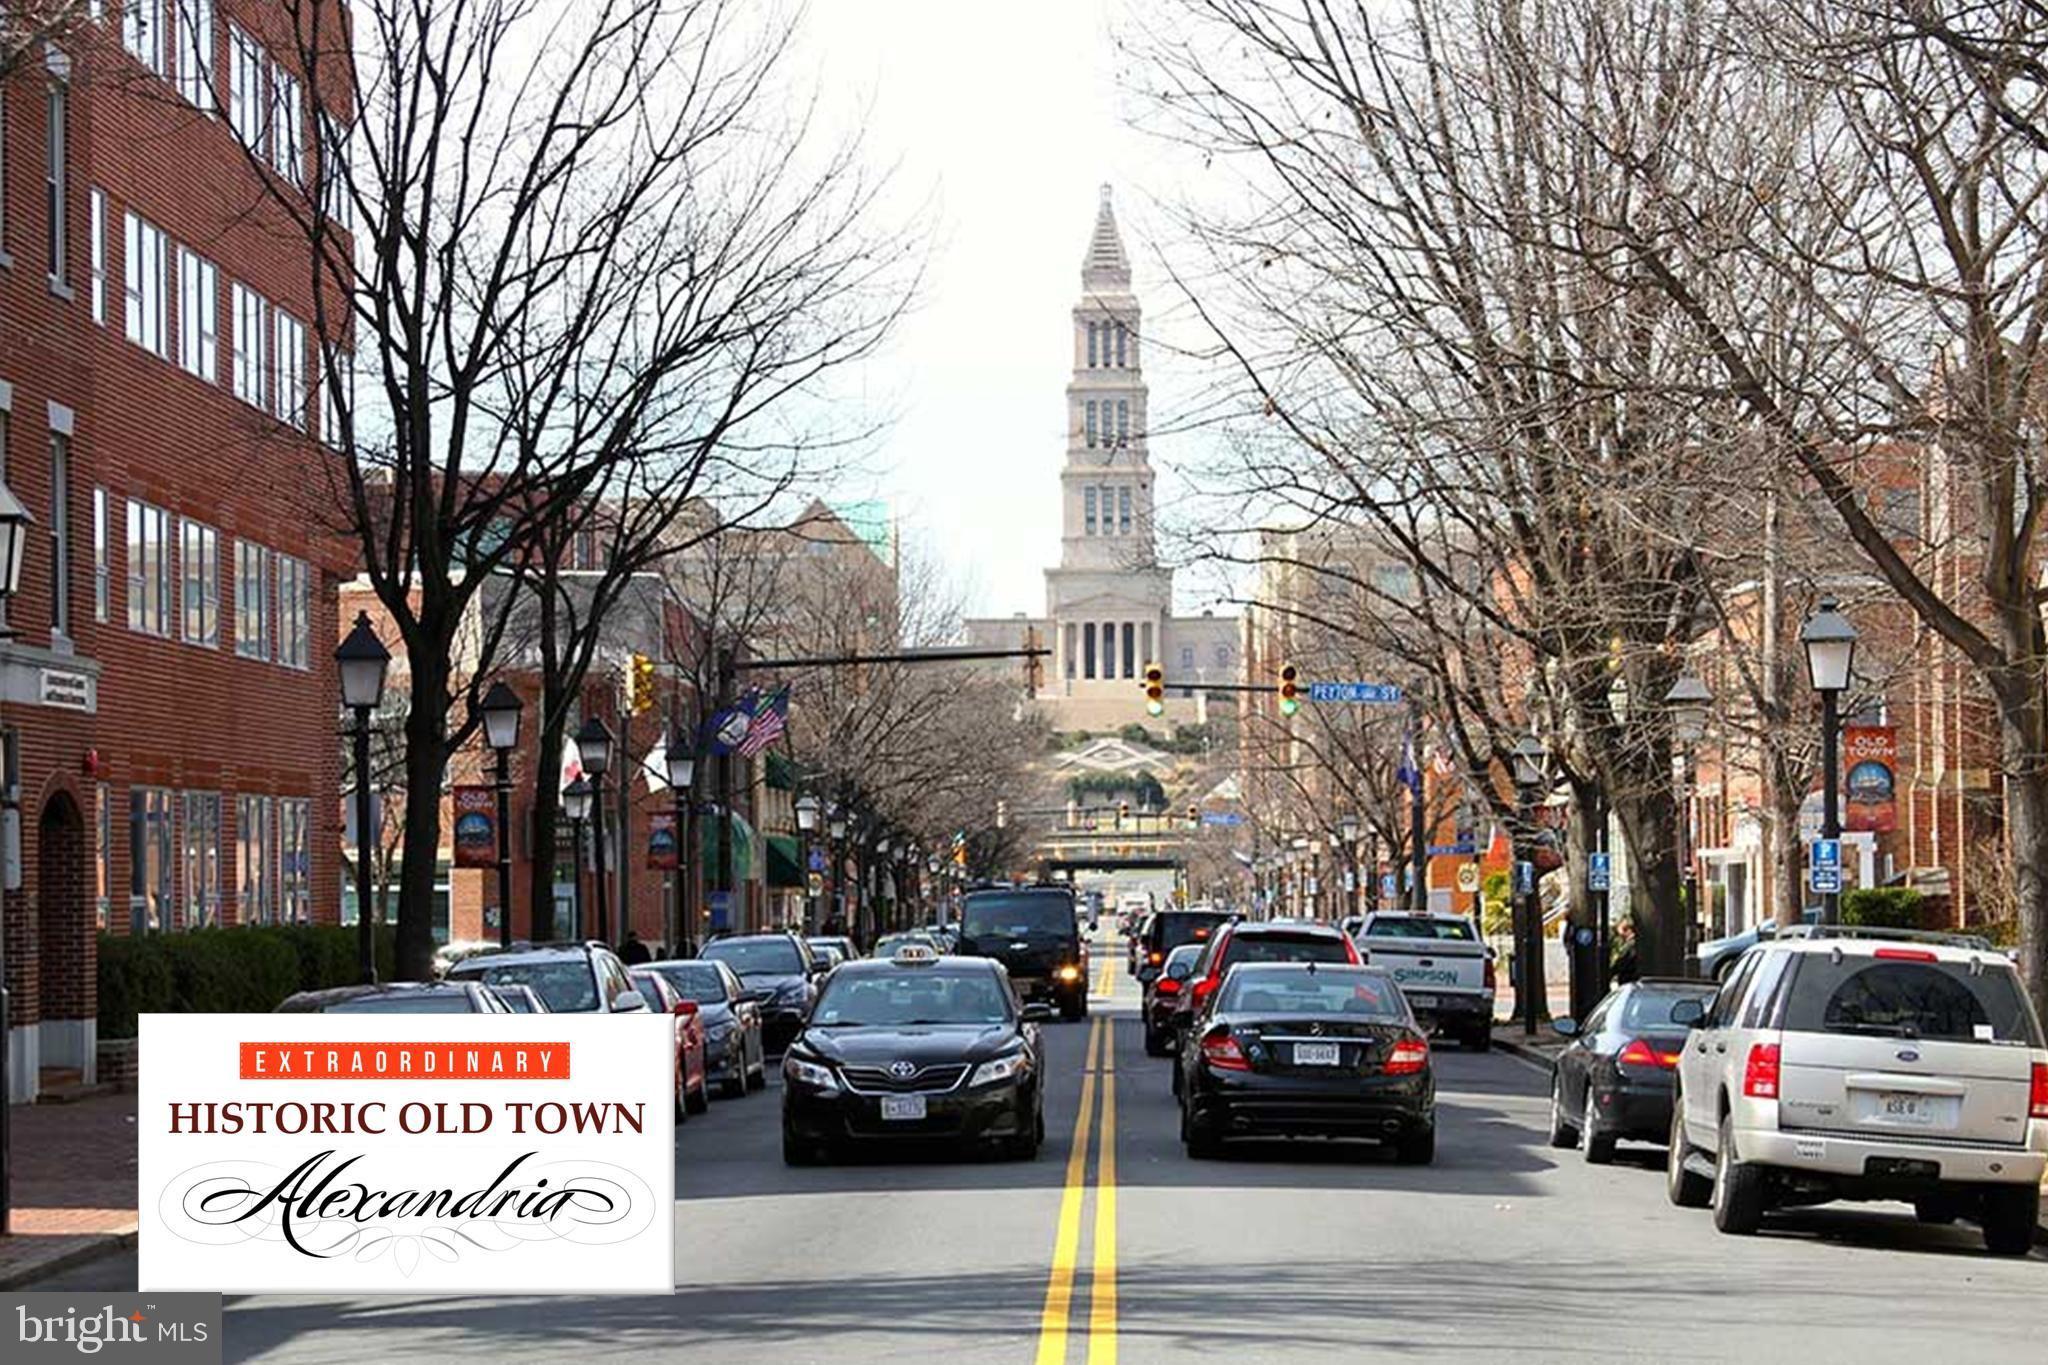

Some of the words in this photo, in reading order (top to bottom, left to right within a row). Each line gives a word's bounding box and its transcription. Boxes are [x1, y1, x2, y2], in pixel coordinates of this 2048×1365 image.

[1314, 683, 1357, 700] PEYTON
[1855, 736, 1888, 748] OLD
[1848, 746, 1895, 758] TOWN
[903, 948, 926, 958] TAXI
[1393, 968, 1458, 985] SIMPSON
